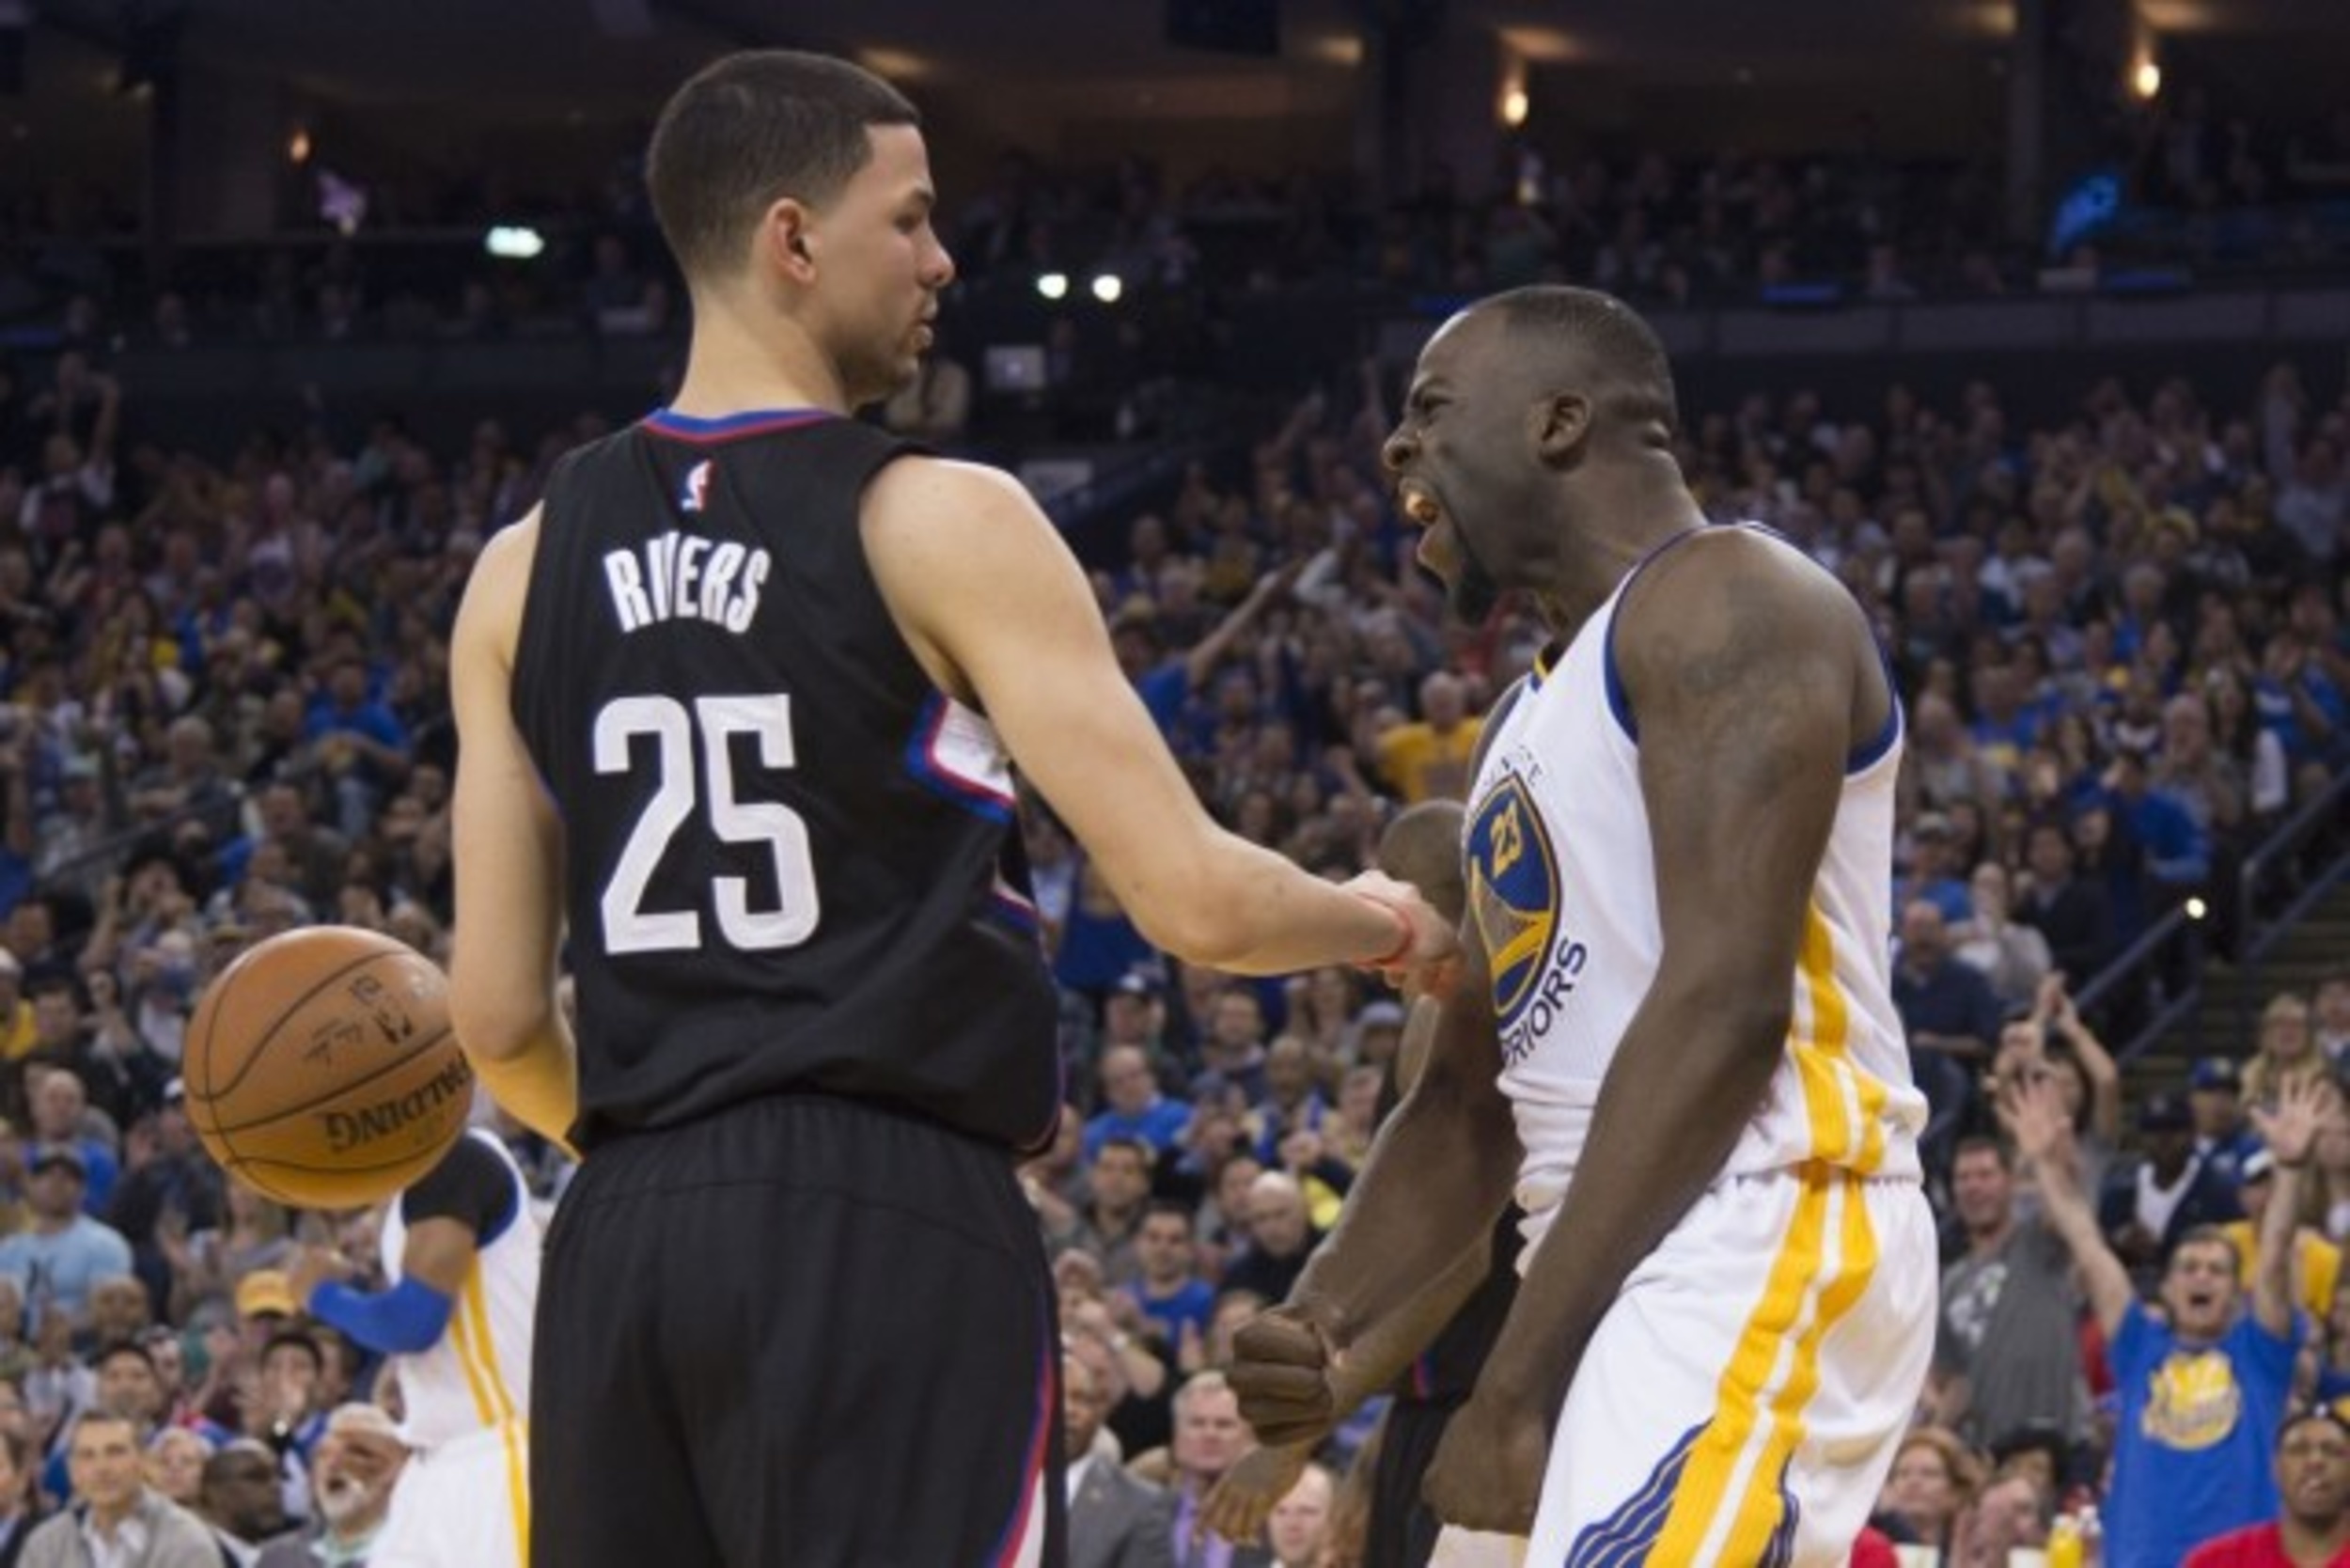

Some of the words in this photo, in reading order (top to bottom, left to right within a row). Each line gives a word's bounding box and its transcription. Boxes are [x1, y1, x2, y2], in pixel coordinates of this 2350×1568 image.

[603, 530, 771, 634] RIVERS
[593, 693, 820, 955] 25
[1489, 799, 1525, 880] 23
[1502, 936, 1588, 1067] RIORS
